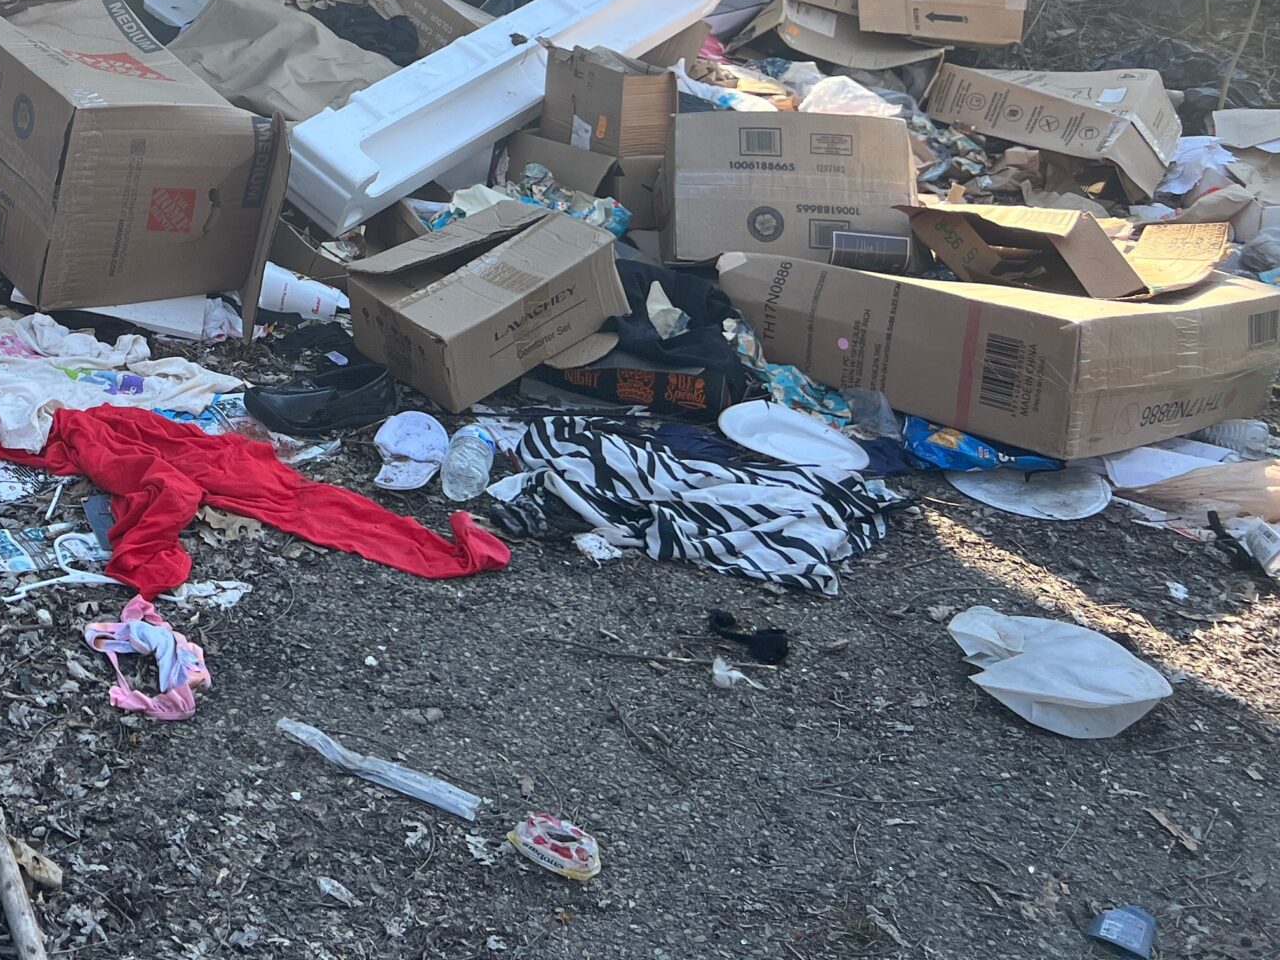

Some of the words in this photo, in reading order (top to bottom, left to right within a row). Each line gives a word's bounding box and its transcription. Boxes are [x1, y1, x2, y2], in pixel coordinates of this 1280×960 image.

[109, 1, 156, 51] MEDIUM
[247, 123, 272, 204] MEDIUM
[729, 160, 795, 172] 1006188665
[152, 188, 192, 232] HOME
[796, 204, 861, 216] 1006188665
[494, 284, 576, 341] LAVACHEY
[763, 260, 793, 340] TH17N0886
[517, 331, 555, 359] Comforter
[556, 322, 572, 336] Set
[1025, 344, 1037, 374] CHINA
[565, 368, 600, 388] NIGHT
[678, 375, 693, 389] BE
[1025, 374, 1034, 385] IN
[665, 385, 706, 404] Spooky
[1020, 385, 1032, 417] MADE
[1140, 392, 1223, 427] TH17N0886
